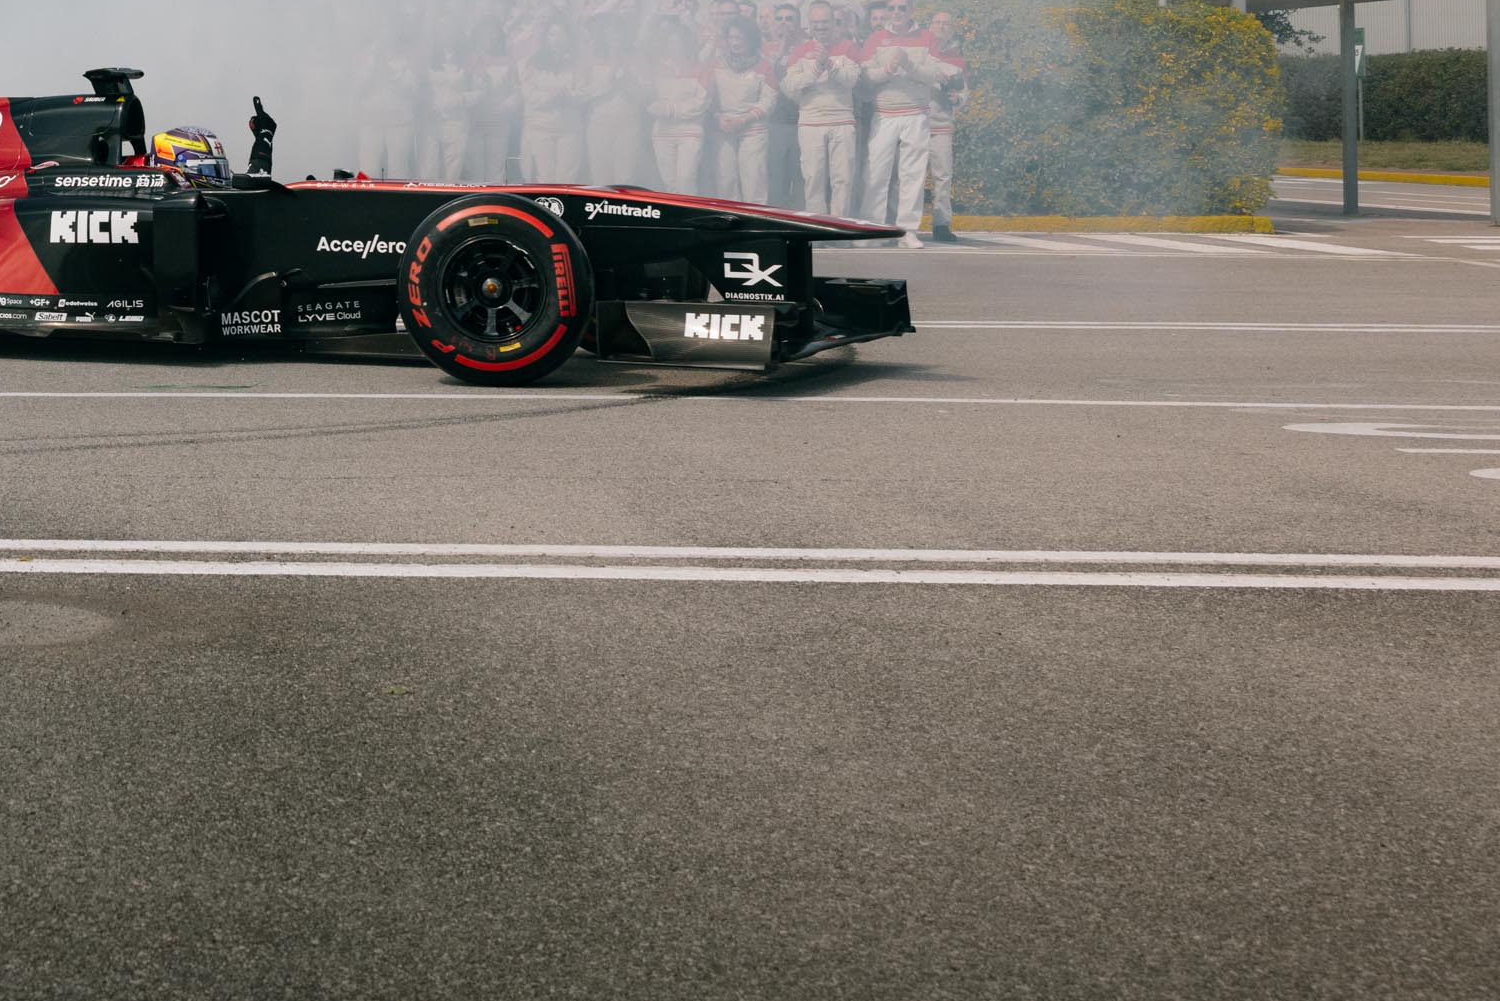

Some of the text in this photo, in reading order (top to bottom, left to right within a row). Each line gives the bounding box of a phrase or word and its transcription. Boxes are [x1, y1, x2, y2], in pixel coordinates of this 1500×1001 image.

[54, 174, 164, 188] sensetime 商汤
[50, 211, 139, 243] KICK
[408, 235, 432, 329] ZERO
[551, 243, 576, 317] PIRELLI
[725, 292, 785, 301] DIAGNOSTIX.AI
[106, 300, 144, 308] AGILIS
[298, 301, 360, 312] SEAGATE
[221, 310, 280, 325] MASCOT
[298, 311, 360, 322] LYVE Cloud
[222, 324, 281, 336] WORKWEAR
[684, 312, 765, 340] KICK
